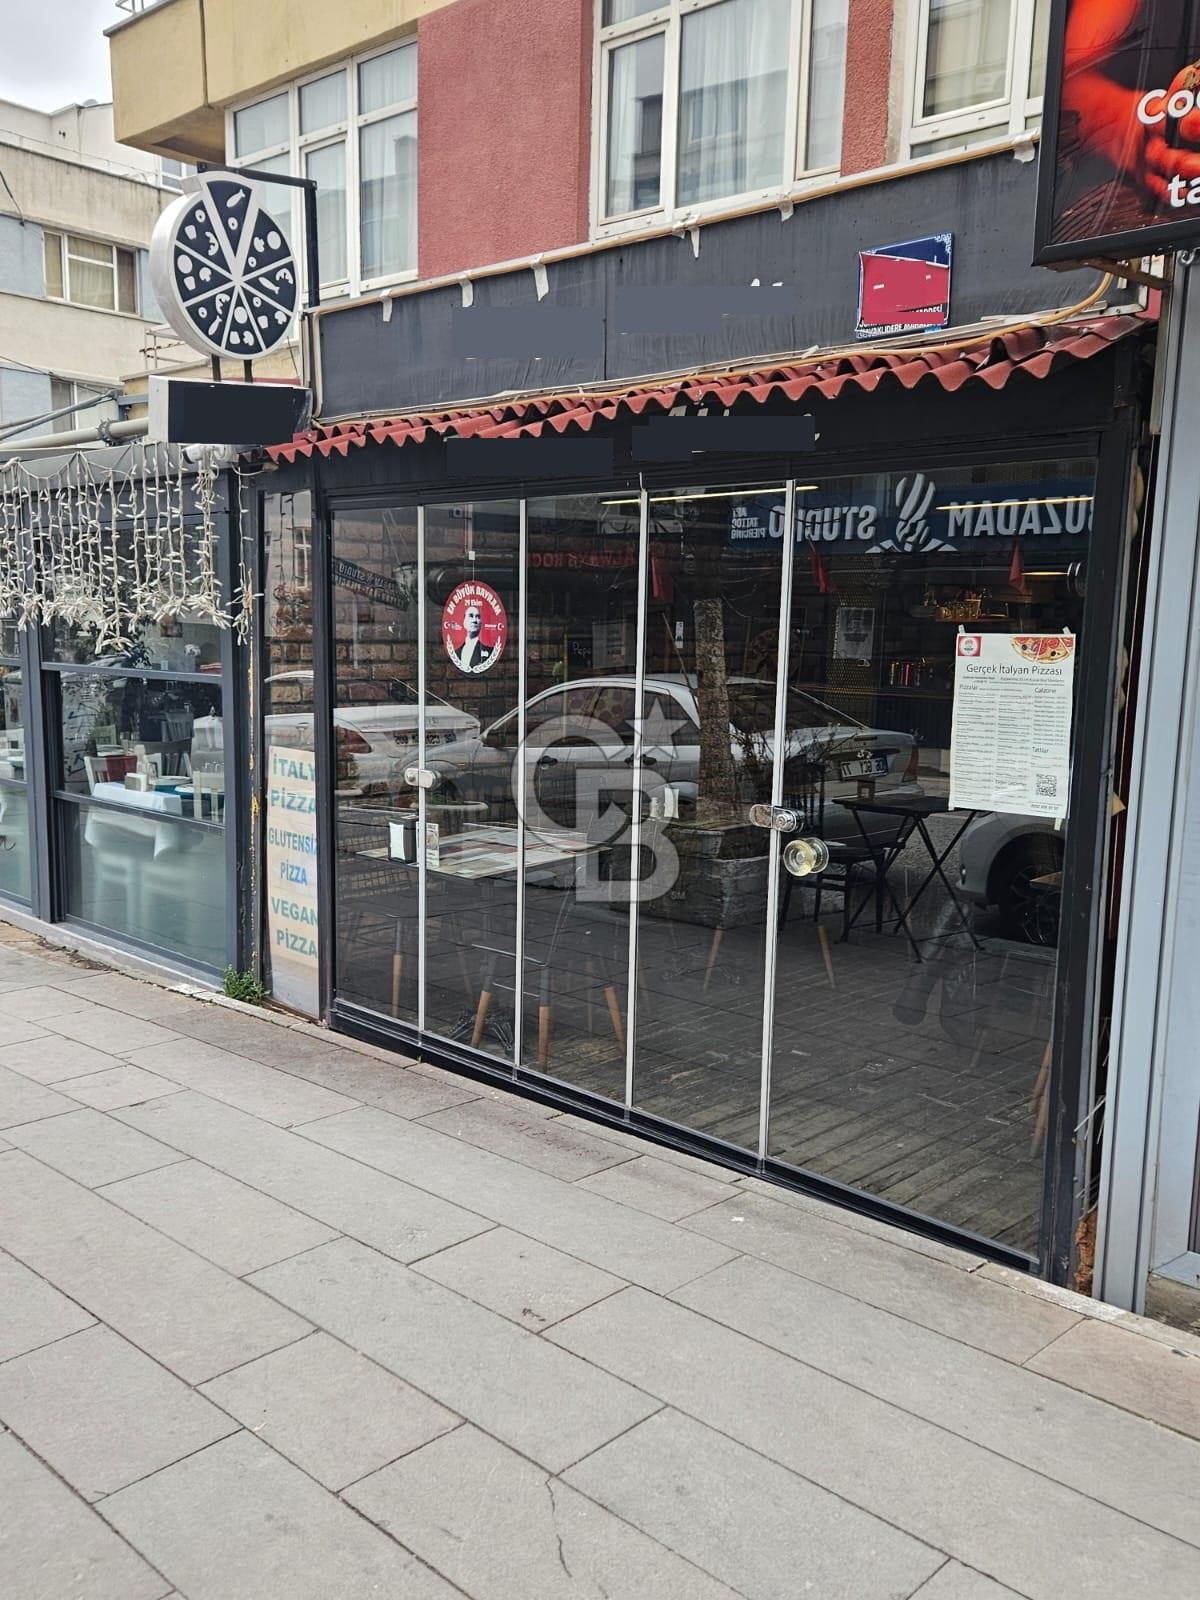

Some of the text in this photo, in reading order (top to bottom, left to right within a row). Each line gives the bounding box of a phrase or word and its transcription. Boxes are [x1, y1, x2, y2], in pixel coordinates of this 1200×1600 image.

[1137, 88, 1200, 125] Co
[446, 583, 502, 616] EN BÜYÜK BAYRAM
[966, 663, 997, 675] Gerçek
[268, 826, 317, 856] GLUTENSİ
[280, 858, 308, 887] PİZZA
[276, 927, 318, 959] PİZZA
